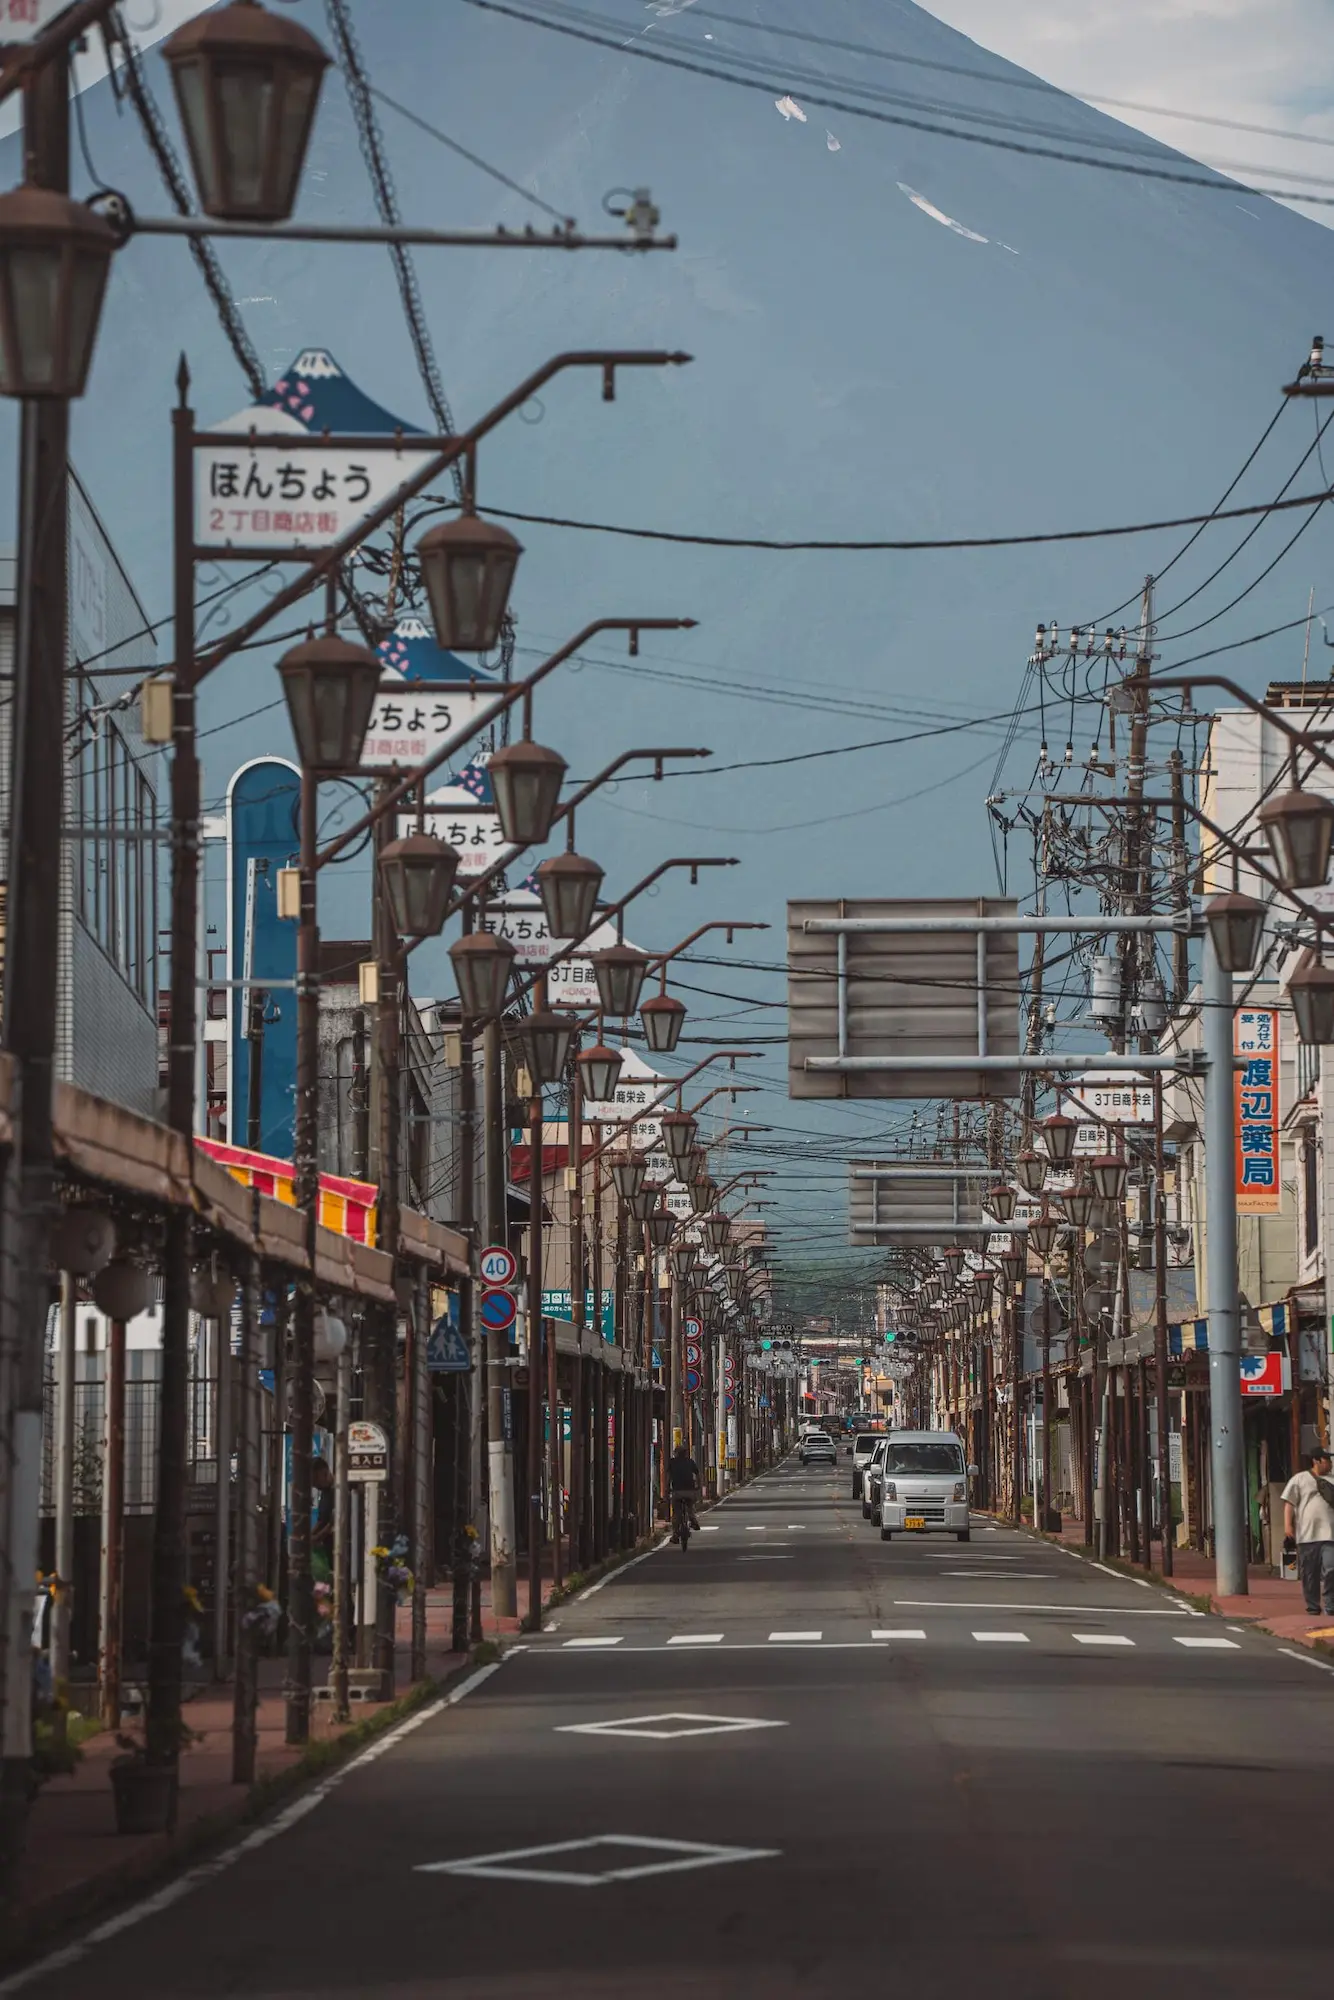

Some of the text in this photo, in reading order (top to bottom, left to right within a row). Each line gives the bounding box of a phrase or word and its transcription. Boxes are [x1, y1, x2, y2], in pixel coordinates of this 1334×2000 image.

[210, 461, 371, 502] ほんちょう
[210, 508, 338, 534] 2丁目商店街
[1257, 1014, 1272, 1050] 処方せん
[1094, 1093, 1151, 1107] 3丁目商栄会
[1241, 1058, 1274, 1186] 渡辺薬局
[486, 1258, 507, 1275] 40
